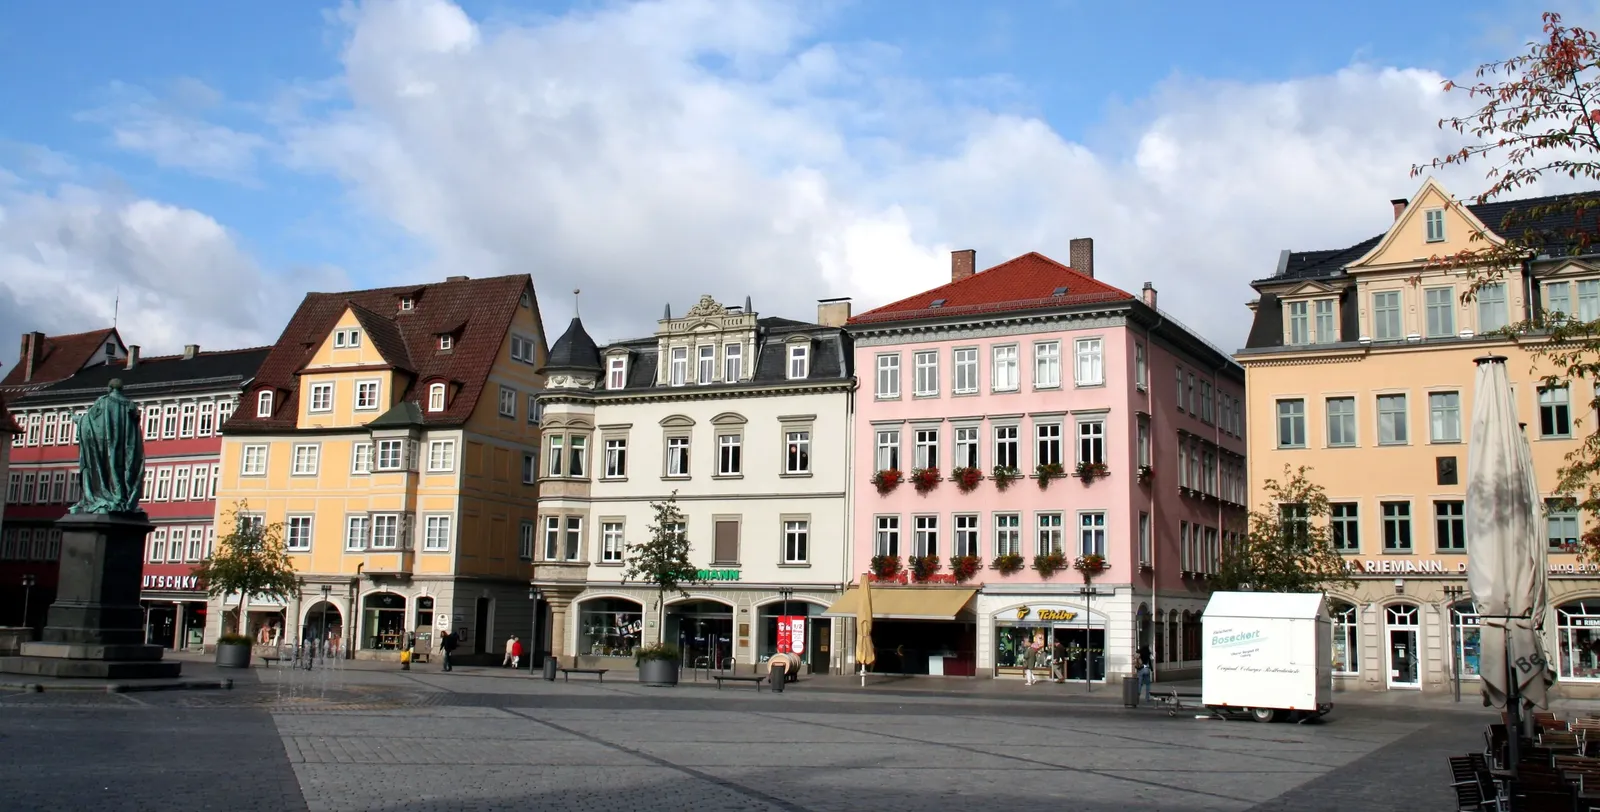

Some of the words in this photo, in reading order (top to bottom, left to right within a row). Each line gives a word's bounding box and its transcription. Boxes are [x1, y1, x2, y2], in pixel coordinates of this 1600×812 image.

[1366, 560, 1448, 572] RIEMANN.
[1549, 563, 1574, 573] ung
[143, 575, 198, 589] UTSCHKY
[1037, 609, 1077, 621] Tchibo
